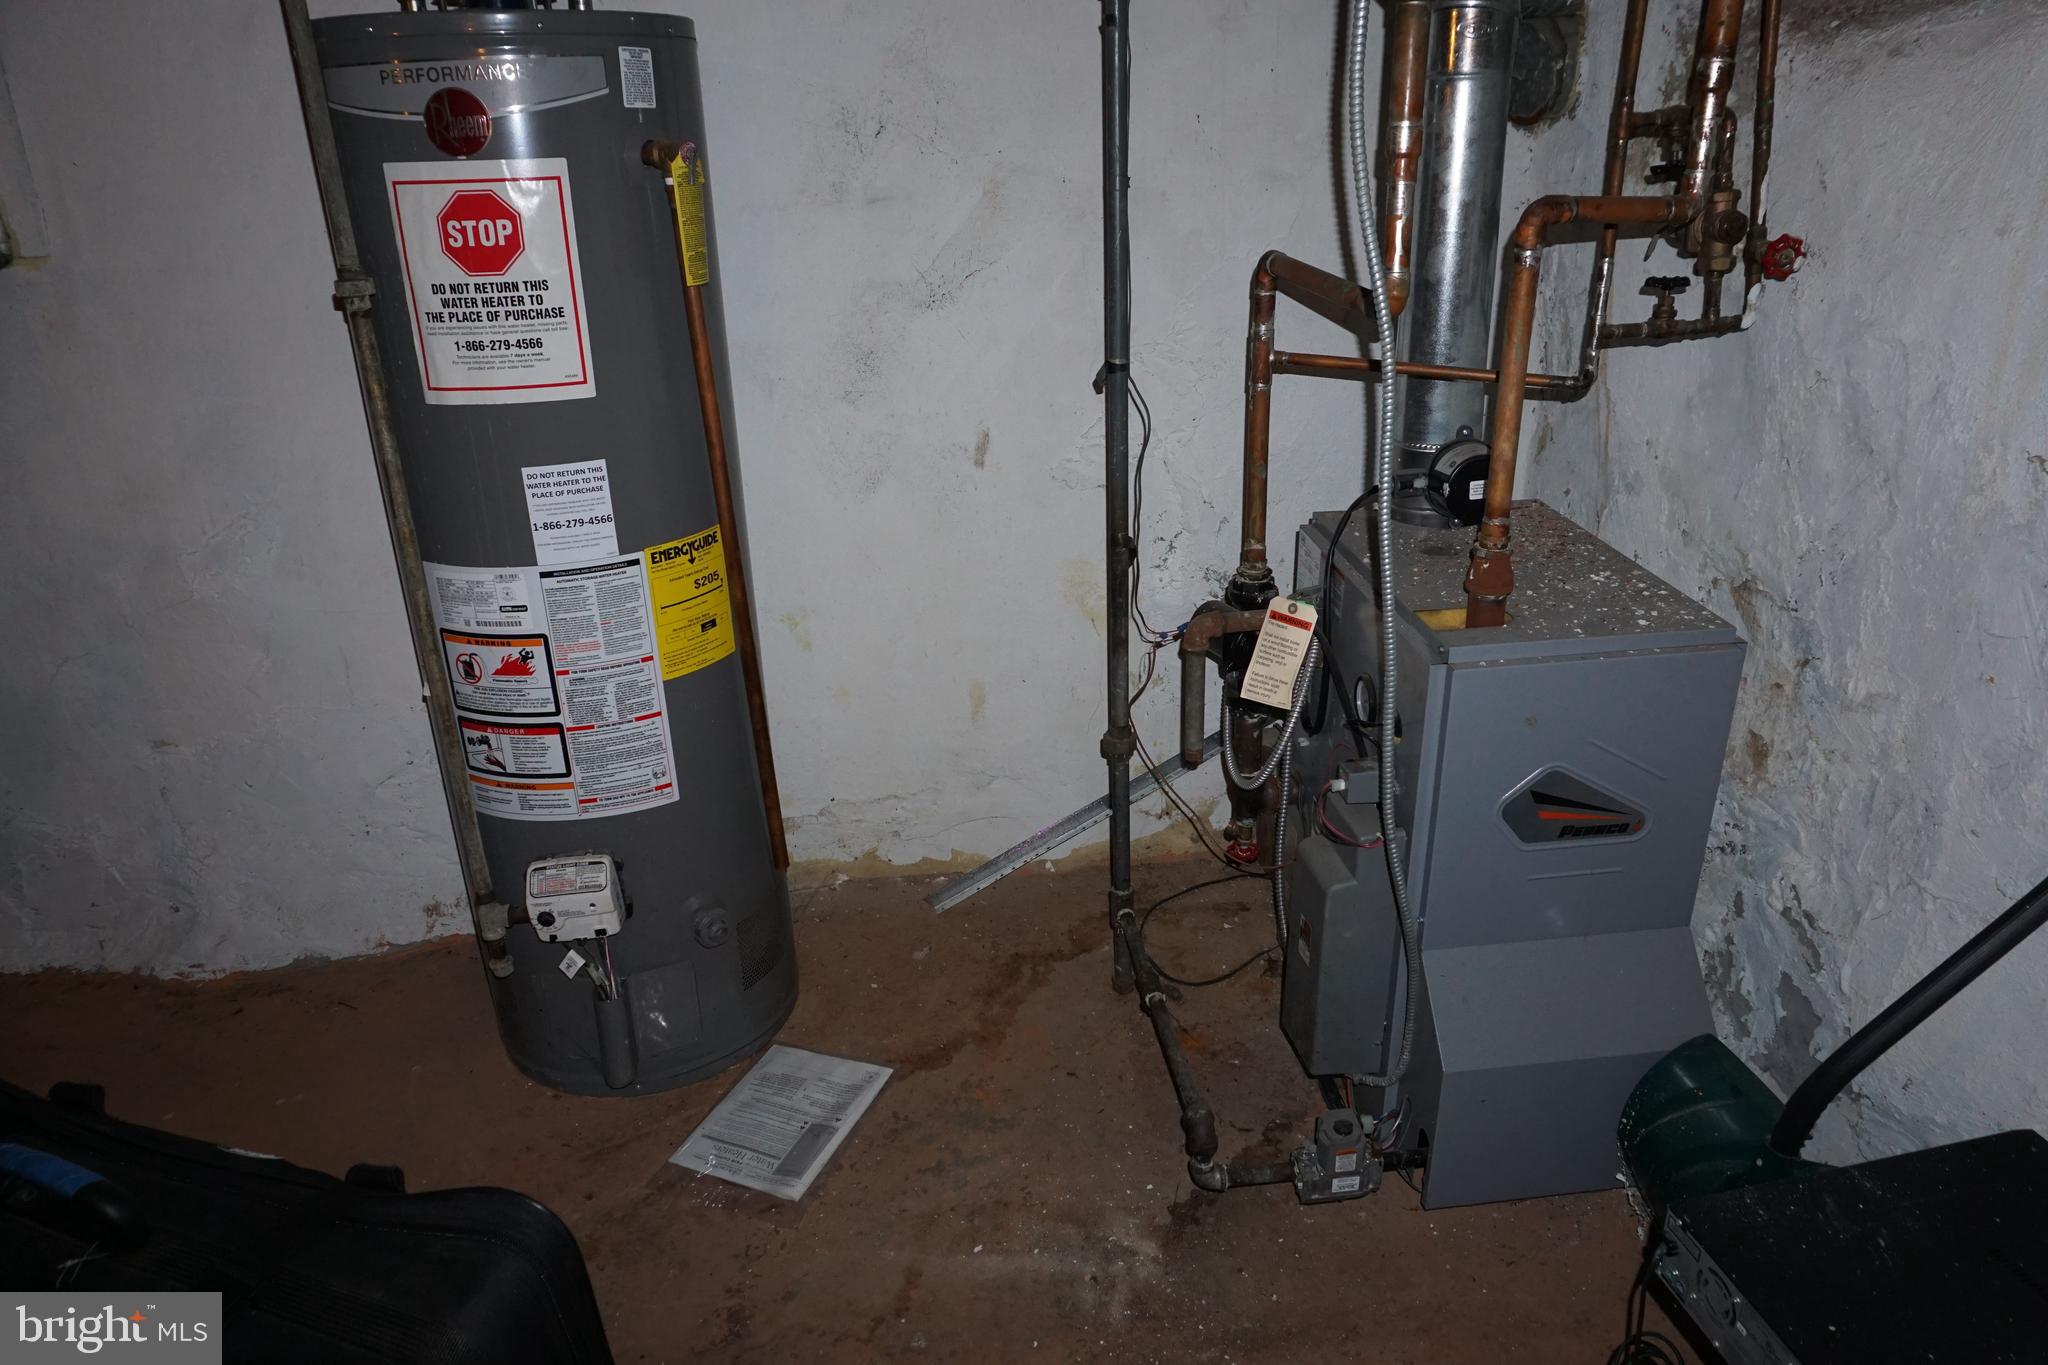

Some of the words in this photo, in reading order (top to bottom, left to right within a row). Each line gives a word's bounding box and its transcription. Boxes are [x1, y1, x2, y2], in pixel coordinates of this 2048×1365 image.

[380, 63, 529, 85] PERFORMANCE
[430, 92, 489, 147] Rheem
[447, 219, 512, 247] STOP
[431, 283, 445, 295] DO
[449, 283, 470, 294] NOT
[474, 281, 519, 294] RETURN
[522, 280, 549, 292] THIS
[441, 297, 478, 309] WATER
[482, 296, 525, 308] HEATER
[528, 294, 543, 306] TO
[425, 312, 445, 323] THE
[448, 311, 483, 323] PLACE
[487, 310, 500, 322] OF
[505, 307, 565, 321] PURCHASE
[455, 338, 543, 351] 1-866-279-4566
[557, 469, 585, 477] RETURN
[567, 485, 604, 495] PURCHASE
[533, 514, 613, 531] 1-866-279-4566
[694, 570, 720, 589] $205
[1278, 614, 1309, 629] WARNING
